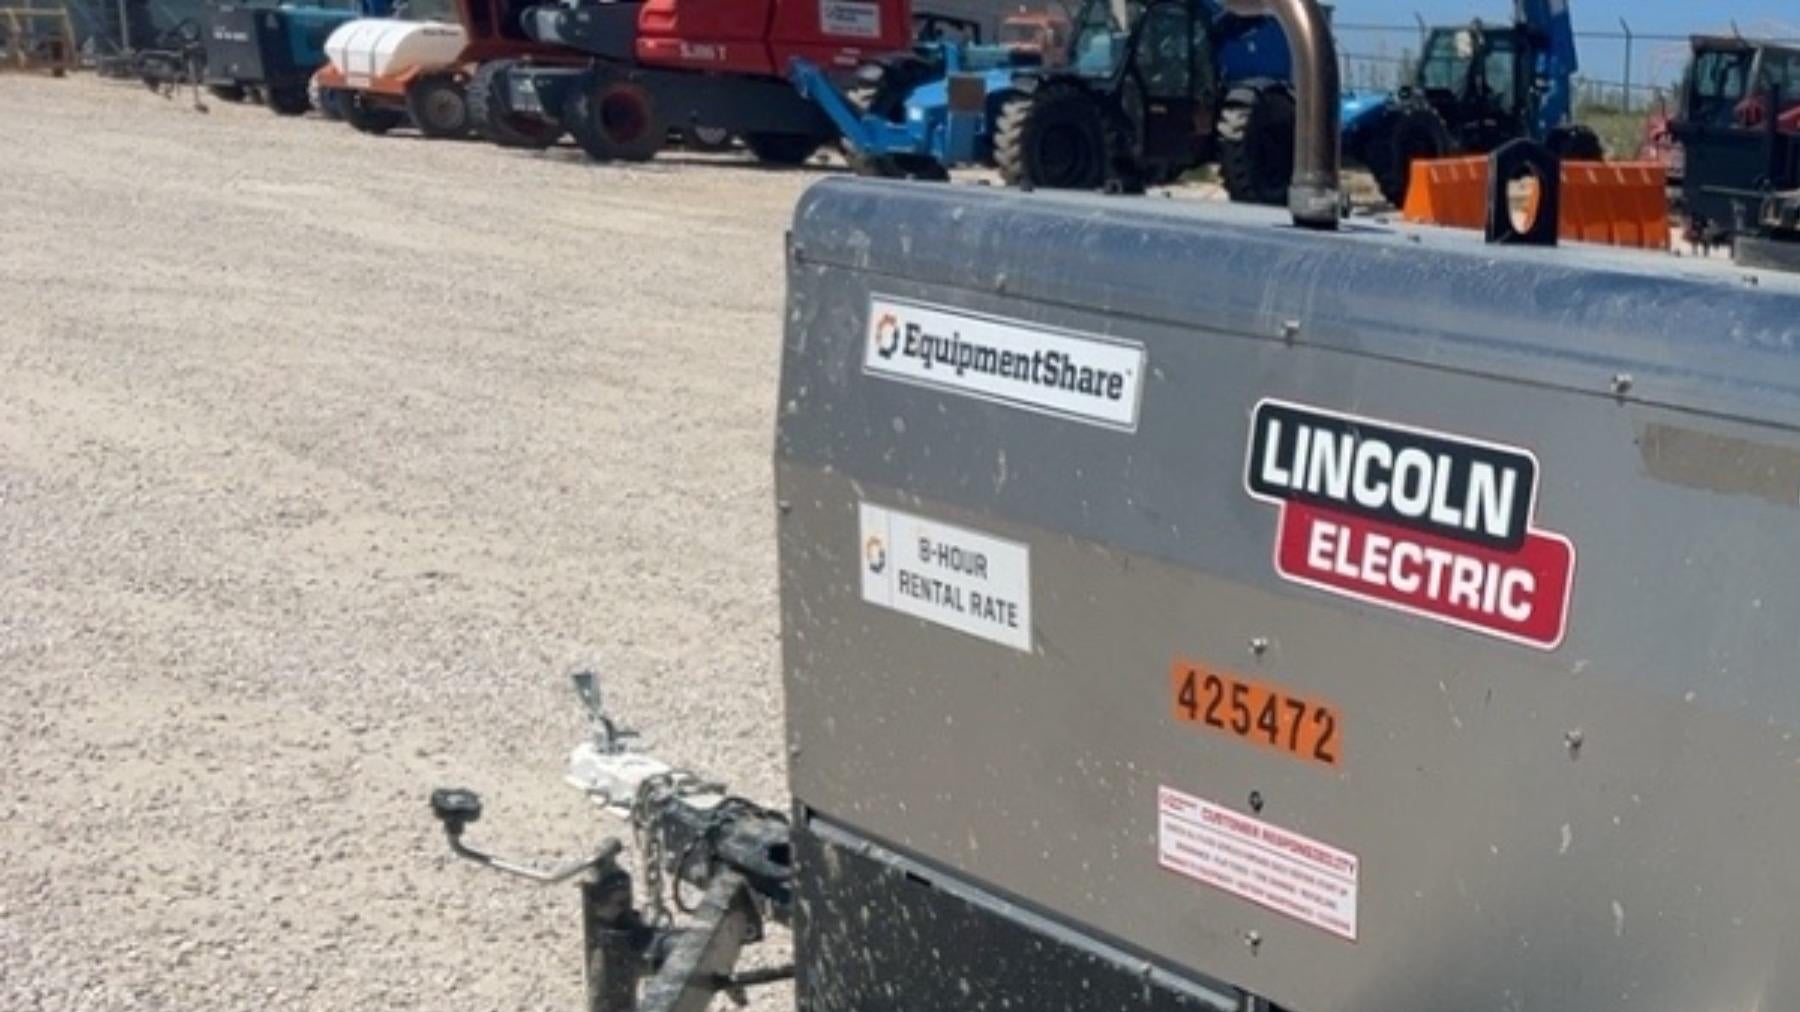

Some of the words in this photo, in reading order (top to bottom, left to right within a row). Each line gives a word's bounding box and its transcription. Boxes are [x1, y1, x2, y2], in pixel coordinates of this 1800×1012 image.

[903, 322, 1125, 400] EquipmentShare
[1262, 419, 1516, 537] LINCOLN
[899, 568, 964, 612] RENTAL
[970, 590, 1019, 628] RATE
[918, 536, 988, 580] 8-HOUR
[1307, 520, 1535, 622] ELECTRIC
[1177, 669, 1335, 763] 425472
